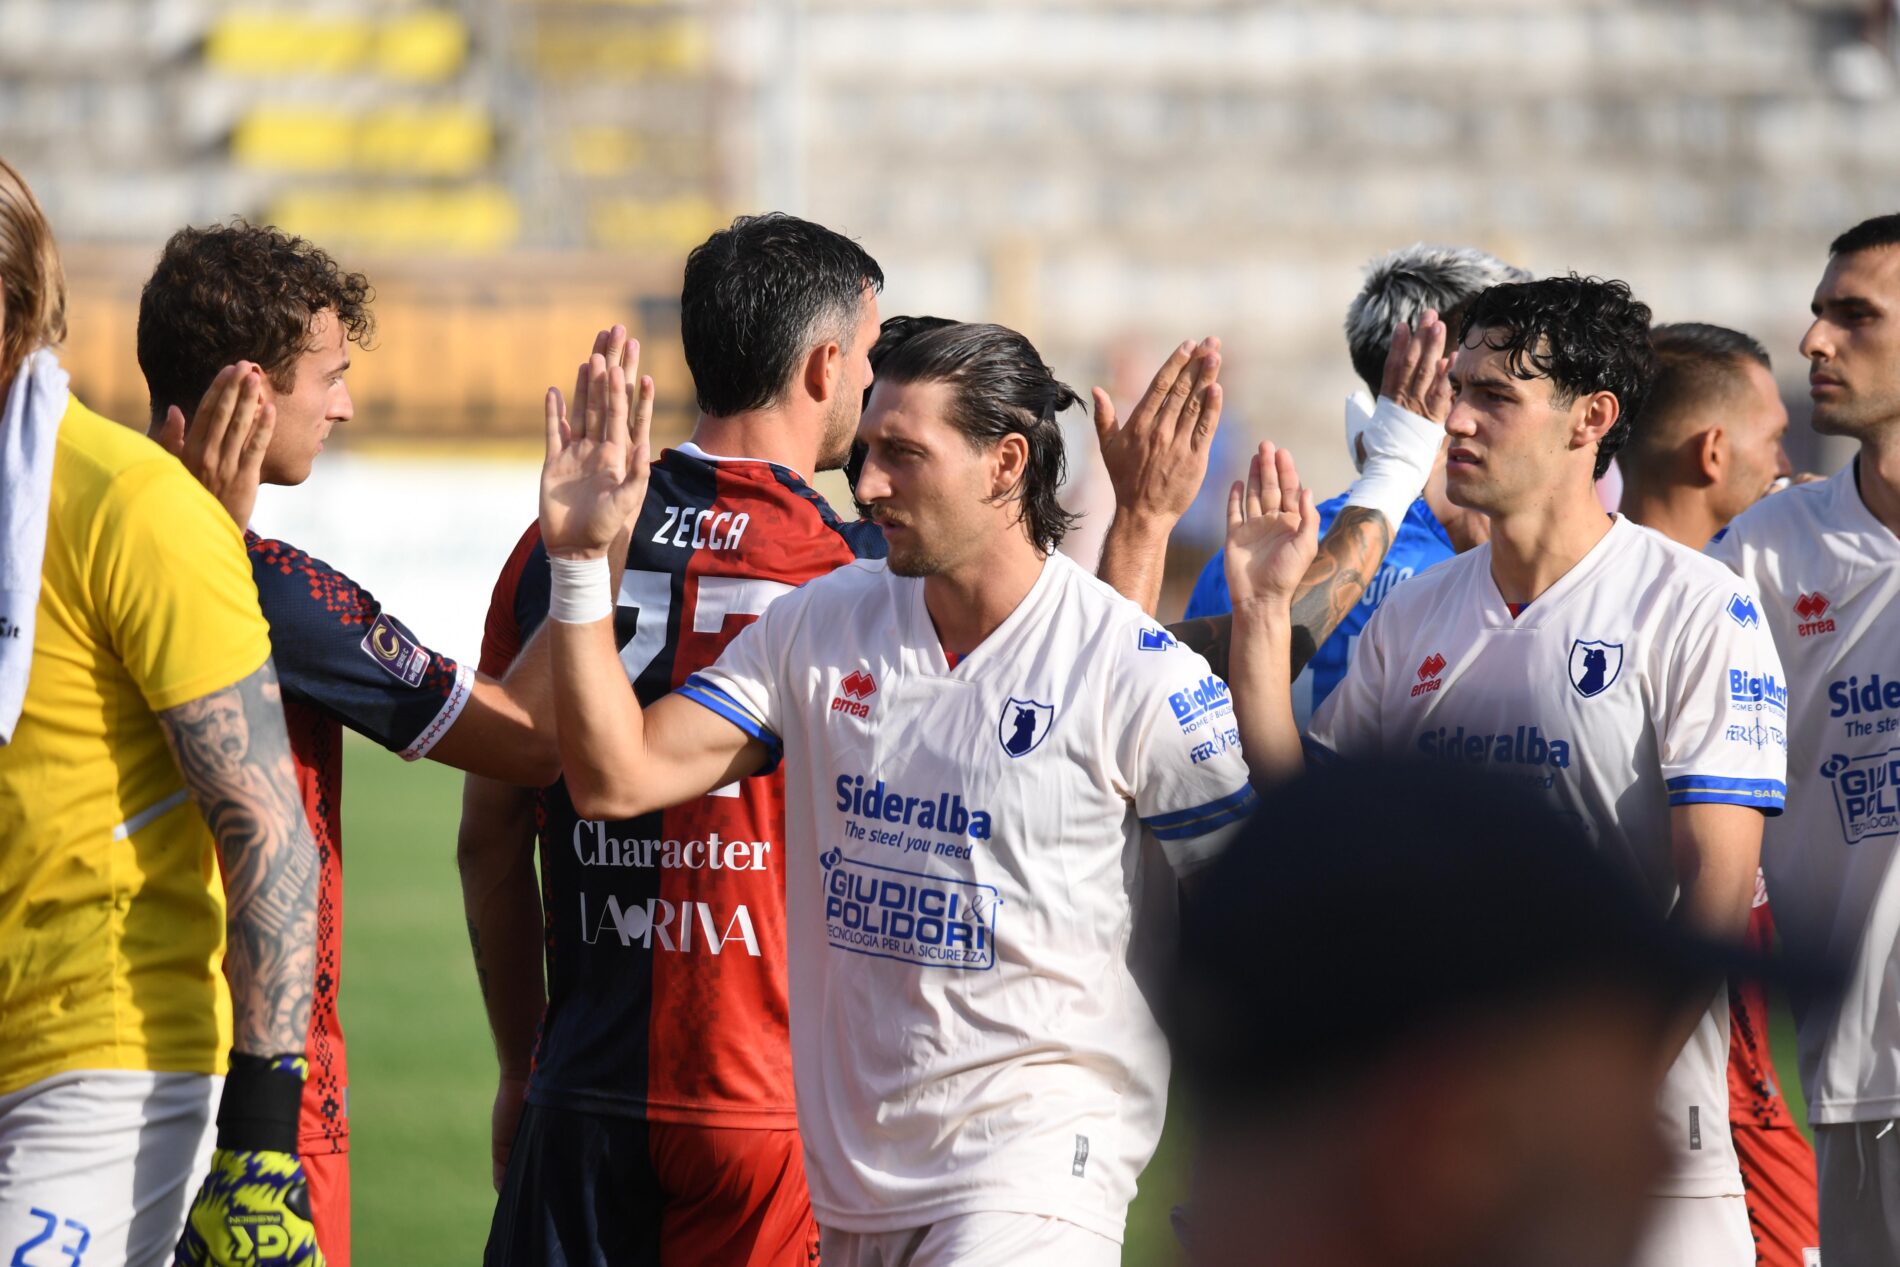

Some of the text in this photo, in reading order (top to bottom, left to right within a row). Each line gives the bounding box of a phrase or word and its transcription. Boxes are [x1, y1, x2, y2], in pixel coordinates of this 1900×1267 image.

[651, 506, 750, 550] ZECCA
[1844, 720, 1872, 738] The
[836, 774, 992, 840] Sideralba
[573, 819, 771, 871] Character
[844, 820, 973, 860] The steel you need
[830, 868, 959, 919] GIUDICI
[826, 895, 986, 950] POLIDORI
[826, 923, 988, 963] TECNOLOGIA PER LA SICUREZZA
